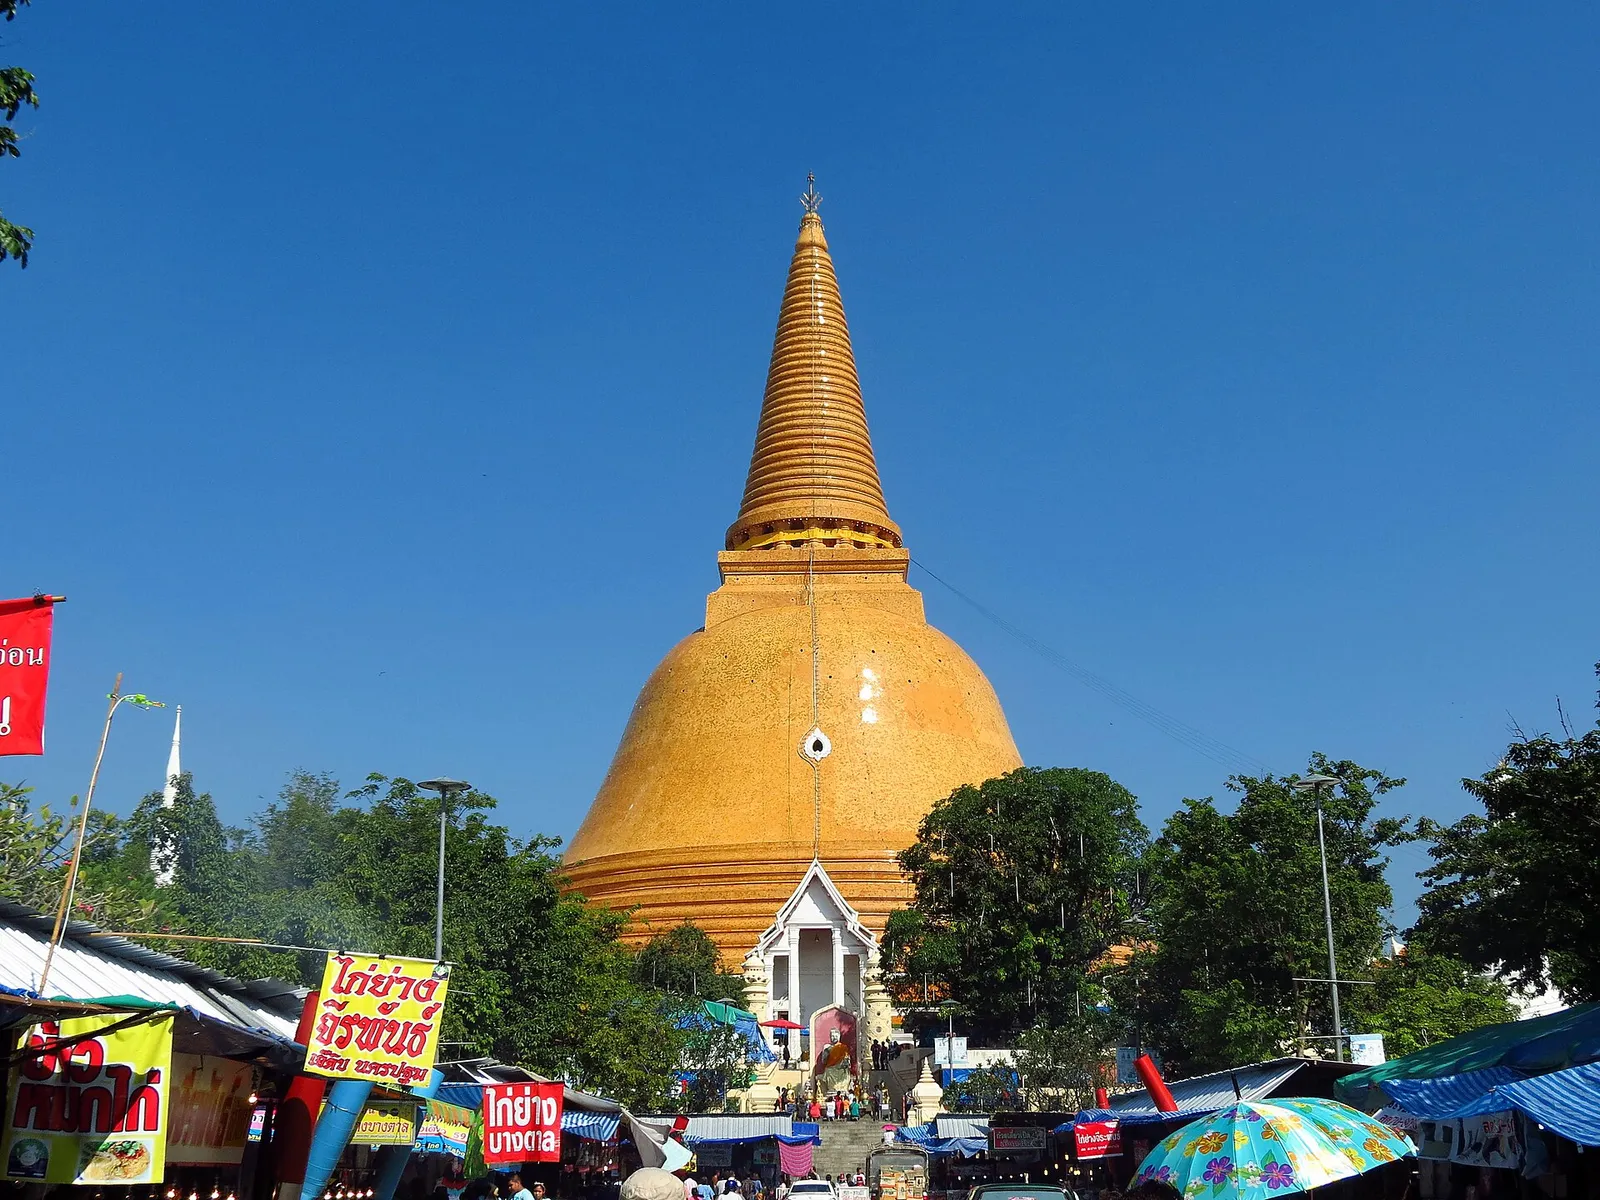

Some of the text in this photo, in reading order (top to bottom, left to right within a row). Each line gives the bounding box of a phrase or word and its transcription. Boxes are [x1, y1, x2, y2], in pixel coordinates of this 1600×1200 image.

[331, 956, 440, 1003] ไก่ย่าง
[354, 1061, 429, 1085] นครปฐม
[12, 1064, 161, 1133] หมกไก่
[485, 1086, 557, 1127] ไก่ย่าง
[489, 1130, 556, 1154] บางตาล
